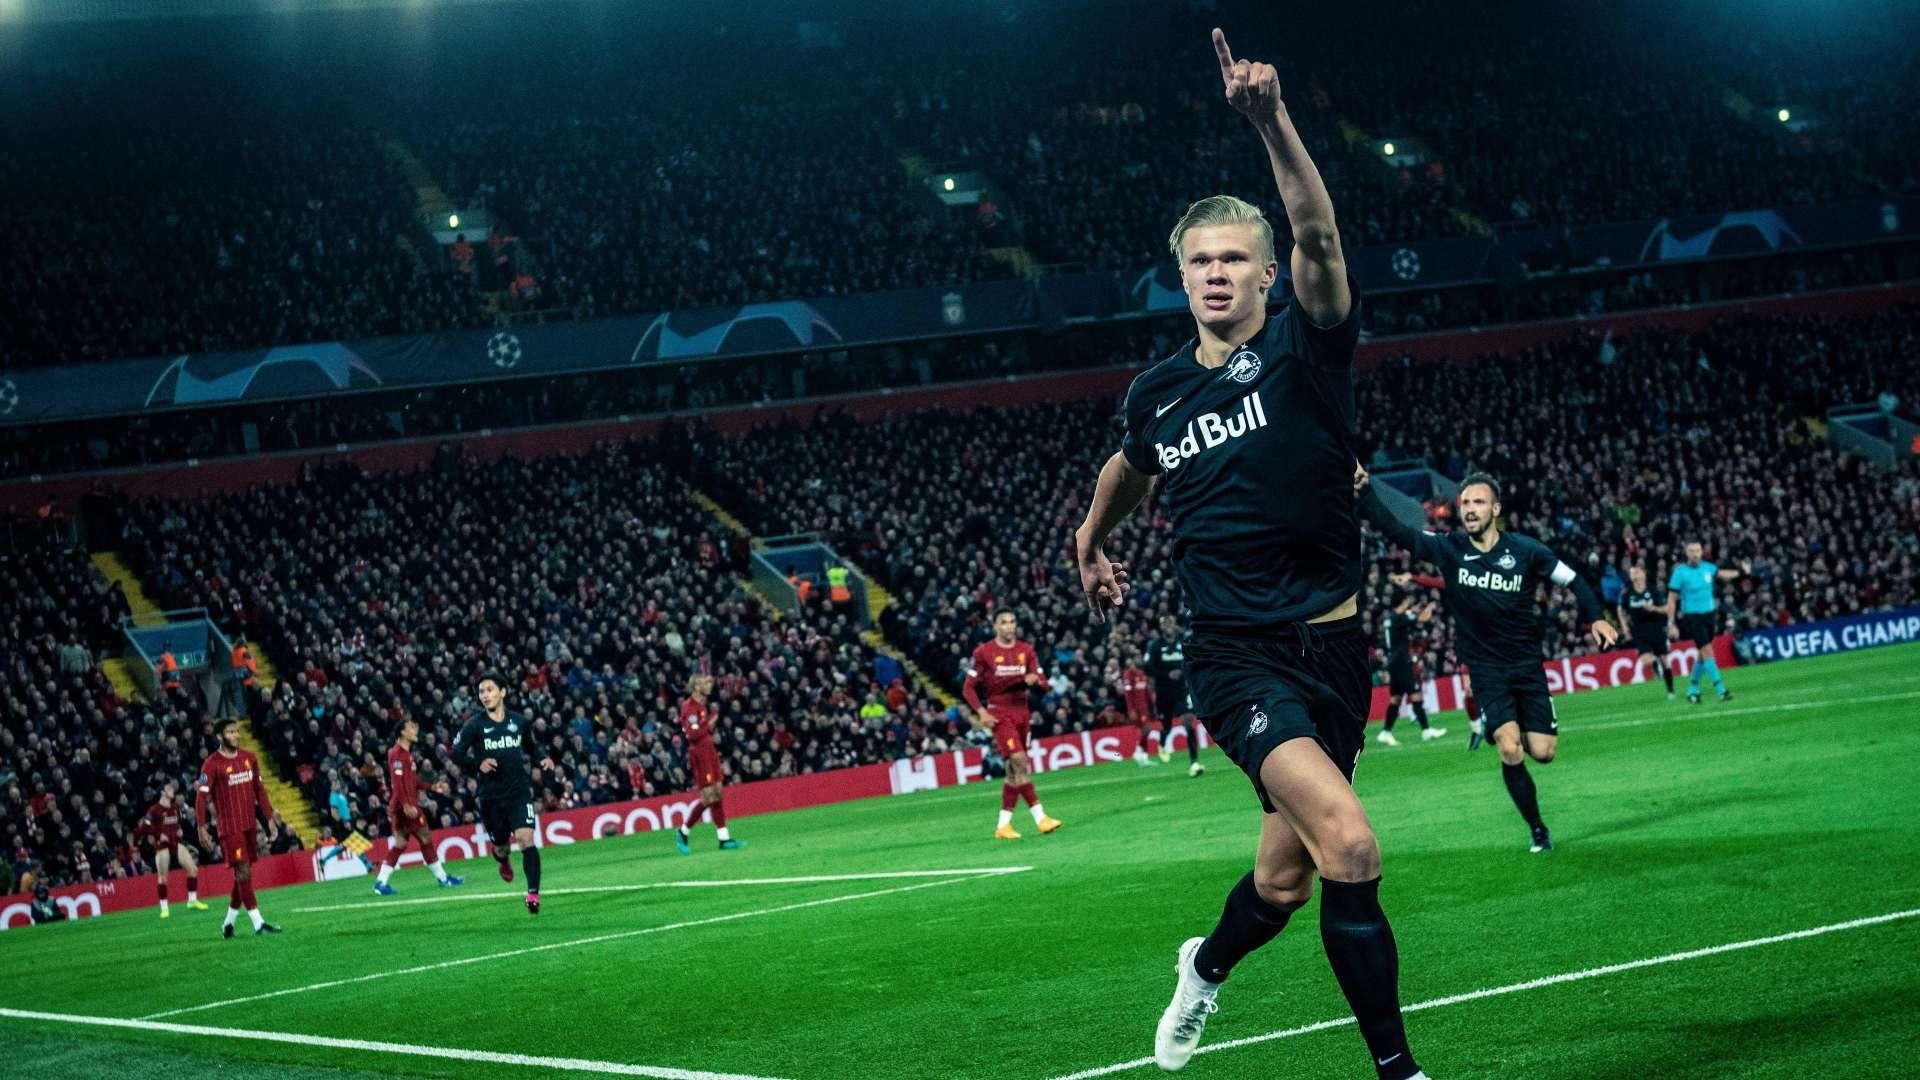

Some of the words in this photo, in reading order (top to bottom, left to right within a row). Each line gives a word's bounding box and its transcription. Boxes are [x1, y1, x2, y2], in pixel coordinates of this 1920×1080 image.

[1197, 391, 1268, 449] Bull
[1458, 567, 1490, 589] Red
[1490, 573, 1523, 592] Bull
[1776, 629, 1838, 658] UEFA
[1842, 616, 1920, 648] CHAMP
[484, 736, 505, 750] Red
